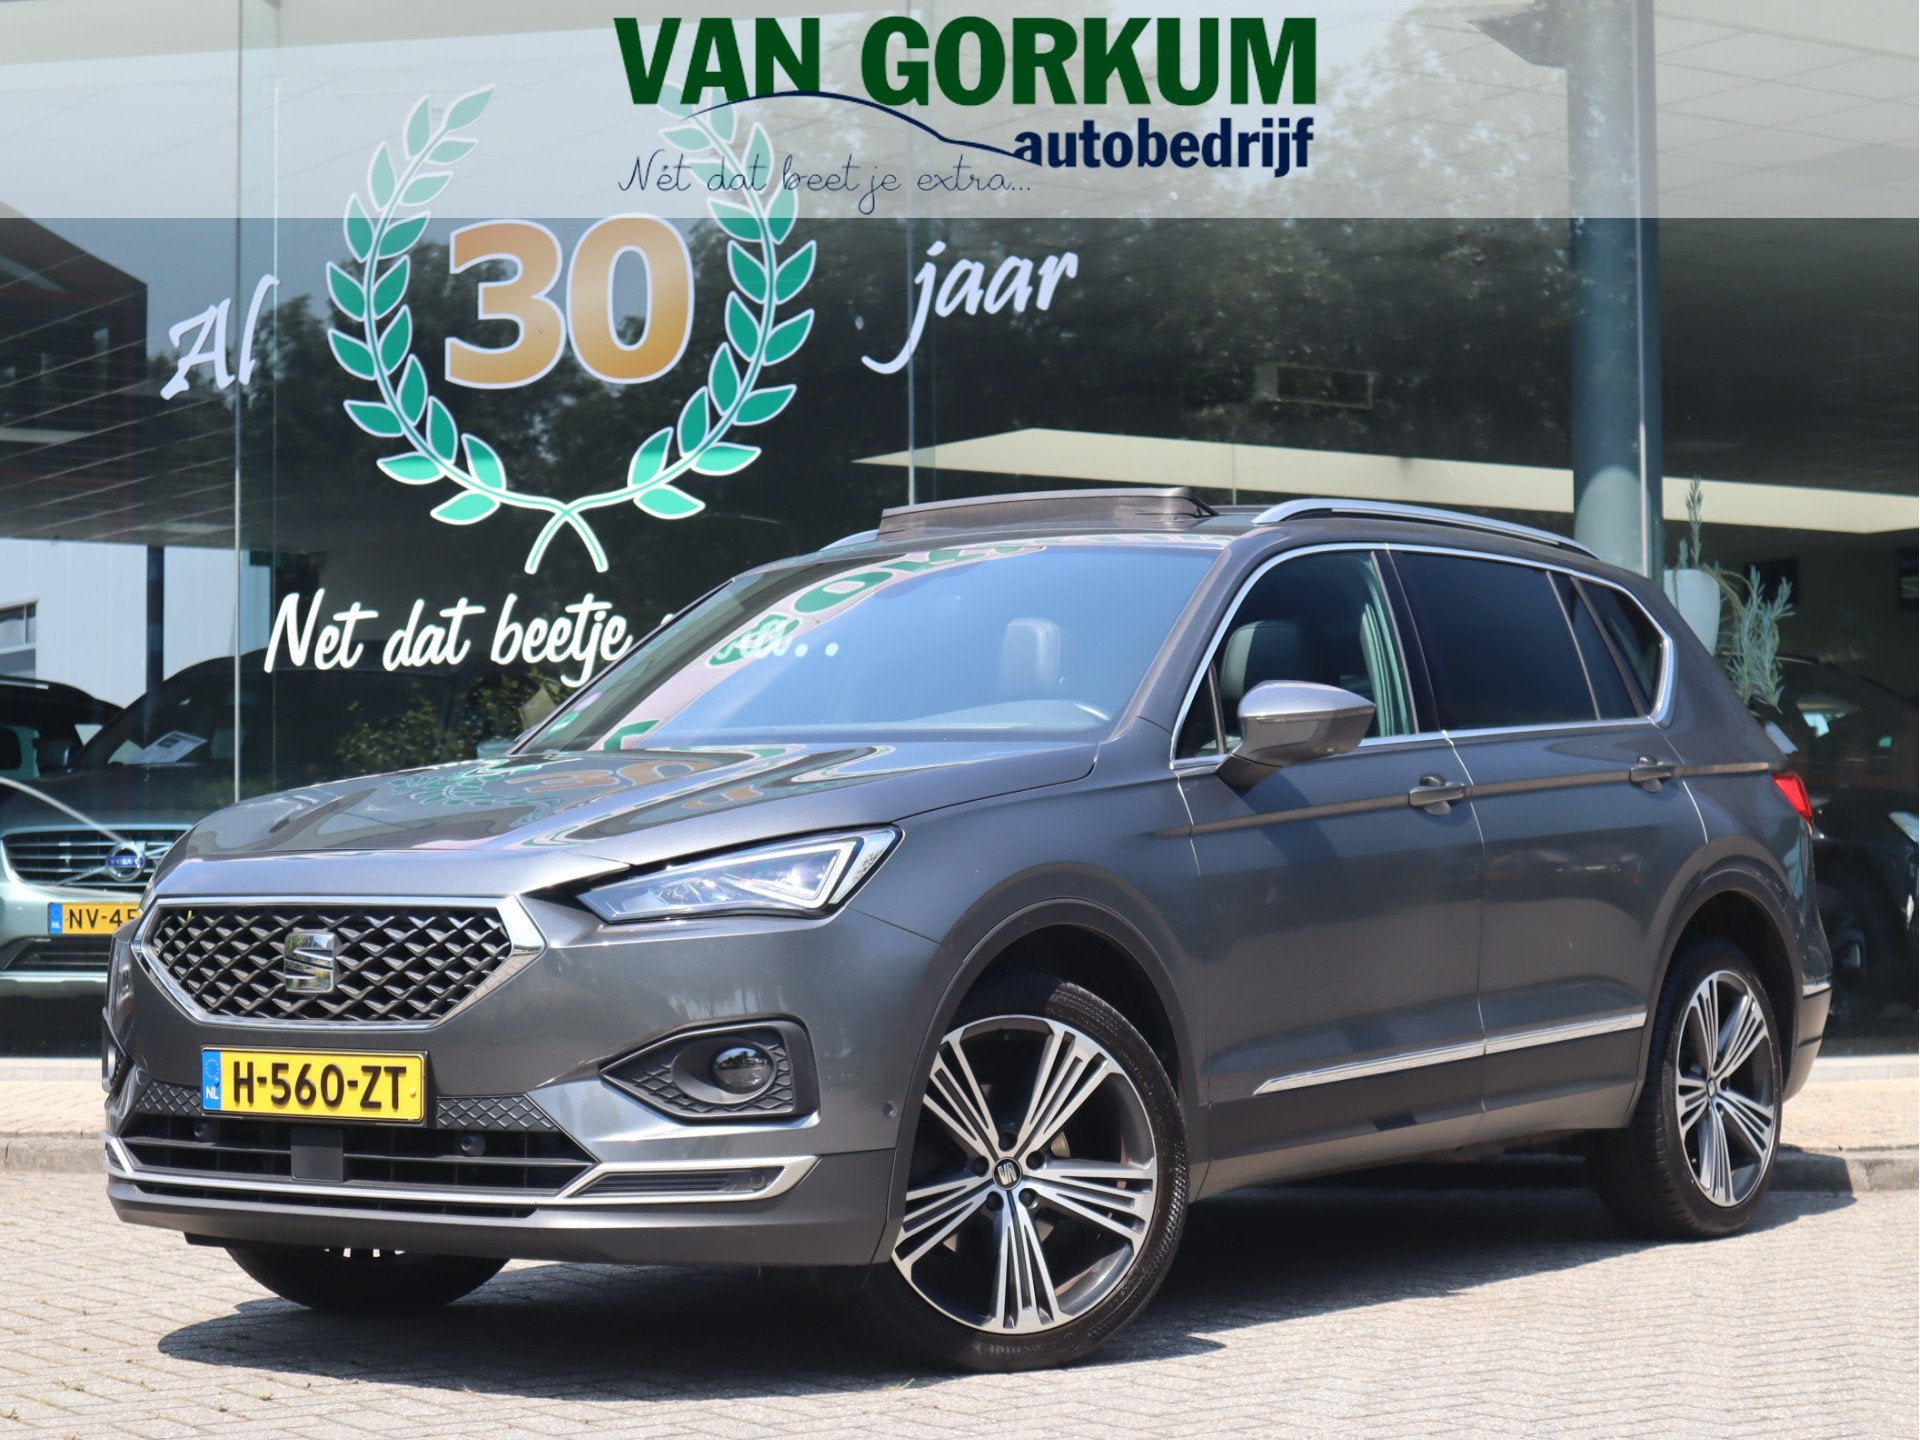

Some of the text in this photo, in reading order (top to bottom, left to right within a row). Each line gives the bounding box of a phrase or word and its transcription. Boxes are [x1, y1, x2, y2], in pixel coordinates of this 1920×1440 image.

[160, 273, 280, 401] Al
[445, 212, 696, 391] 30
[861, 239, 1080, 375] jaar
[264, 587, 380, 673] Net
[383, 597, 487, 672] dat
[490, 592, 634, 688] beetje
[205, 1086, 219, 1100] NL
[233, 1060, 407, 1110] H-560-ZT
